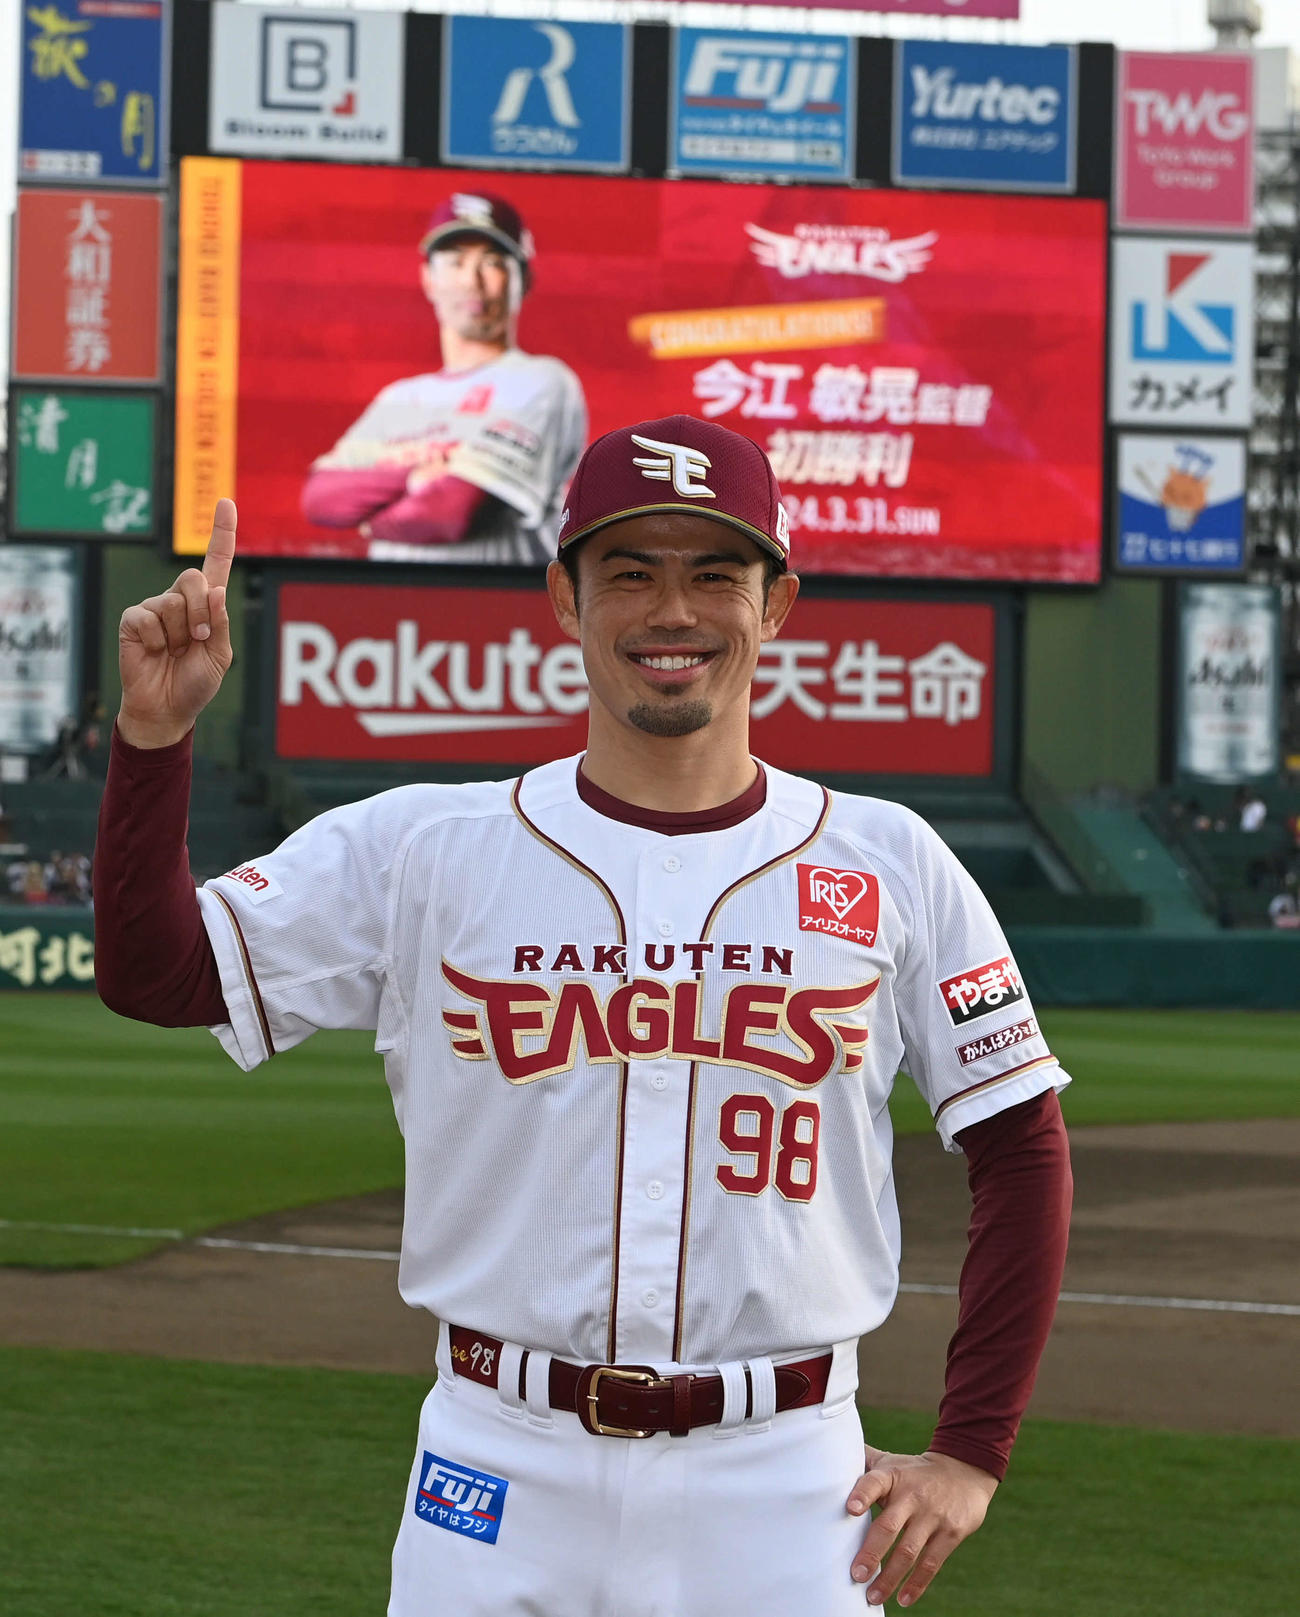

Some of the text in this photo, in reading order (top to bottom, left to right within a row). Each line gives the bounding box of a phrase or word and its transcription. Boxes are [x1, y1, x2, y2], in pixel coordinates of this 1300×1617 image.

[286, 38, 328, 92] B
[684, 36, 844, 113] Fuji
[910, 64, 1060, 124] Yurtec
[1126, 88, 1249, 141] TWG
[1131, 375, 1235, 413] カメイ
[229, 865, 270, 892] uten
[801, 915, 875, 943] アイリスオーヤマ
[513, 943, 795, 976] RAKUTEN
[440, 955, 882, 1089] EAGLES
[715, 1092, 821, 1203] 98
[469, 1342, 496, 1376] 98
[423, 1462, 498, 1513] Fuji
[419, 1499, 489, 1534] タイヤはフジ
